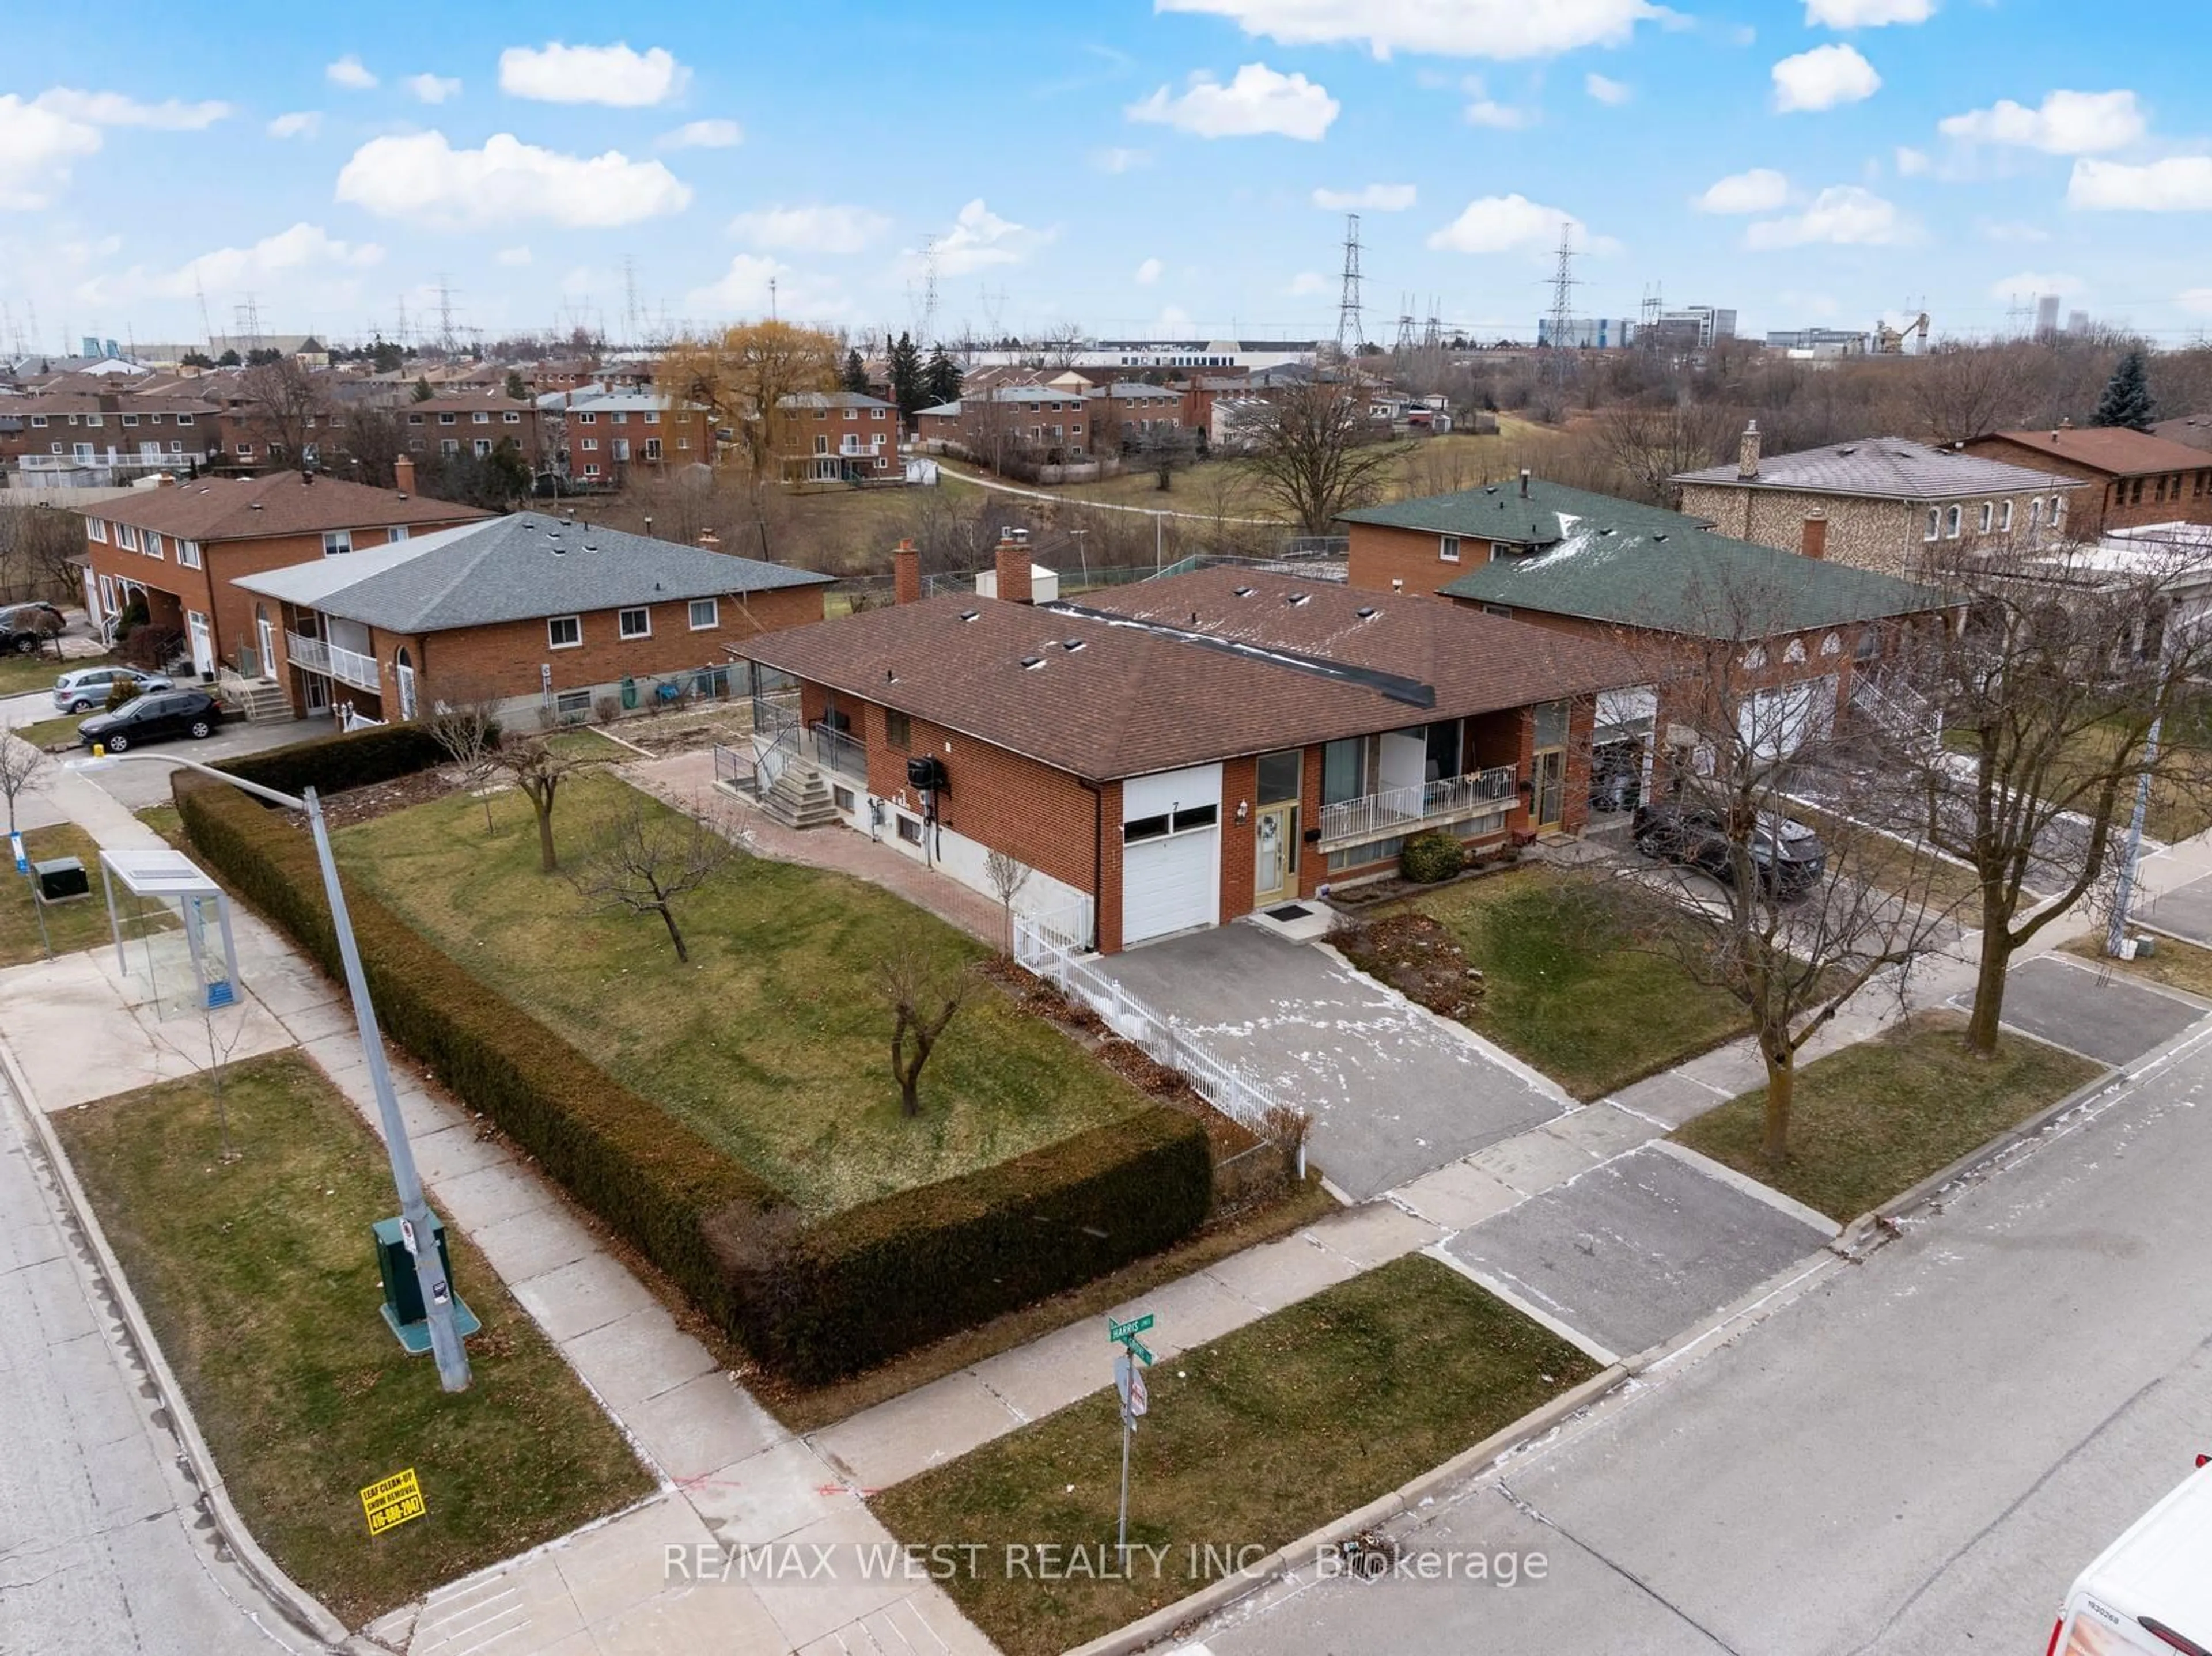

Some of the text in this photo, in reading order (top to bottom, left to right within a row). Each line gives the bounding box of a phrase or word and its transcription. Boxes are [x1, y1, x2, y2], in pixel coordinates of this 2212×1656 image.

[1172, 801, 1179, 811] 7
[1112, 1322, 1139, 1339] HARRIS
[363, 1472, 412, 1500] LEAF CLEAN-UP
[366, 1484, 417, 1511] SNOW REMOVAL
